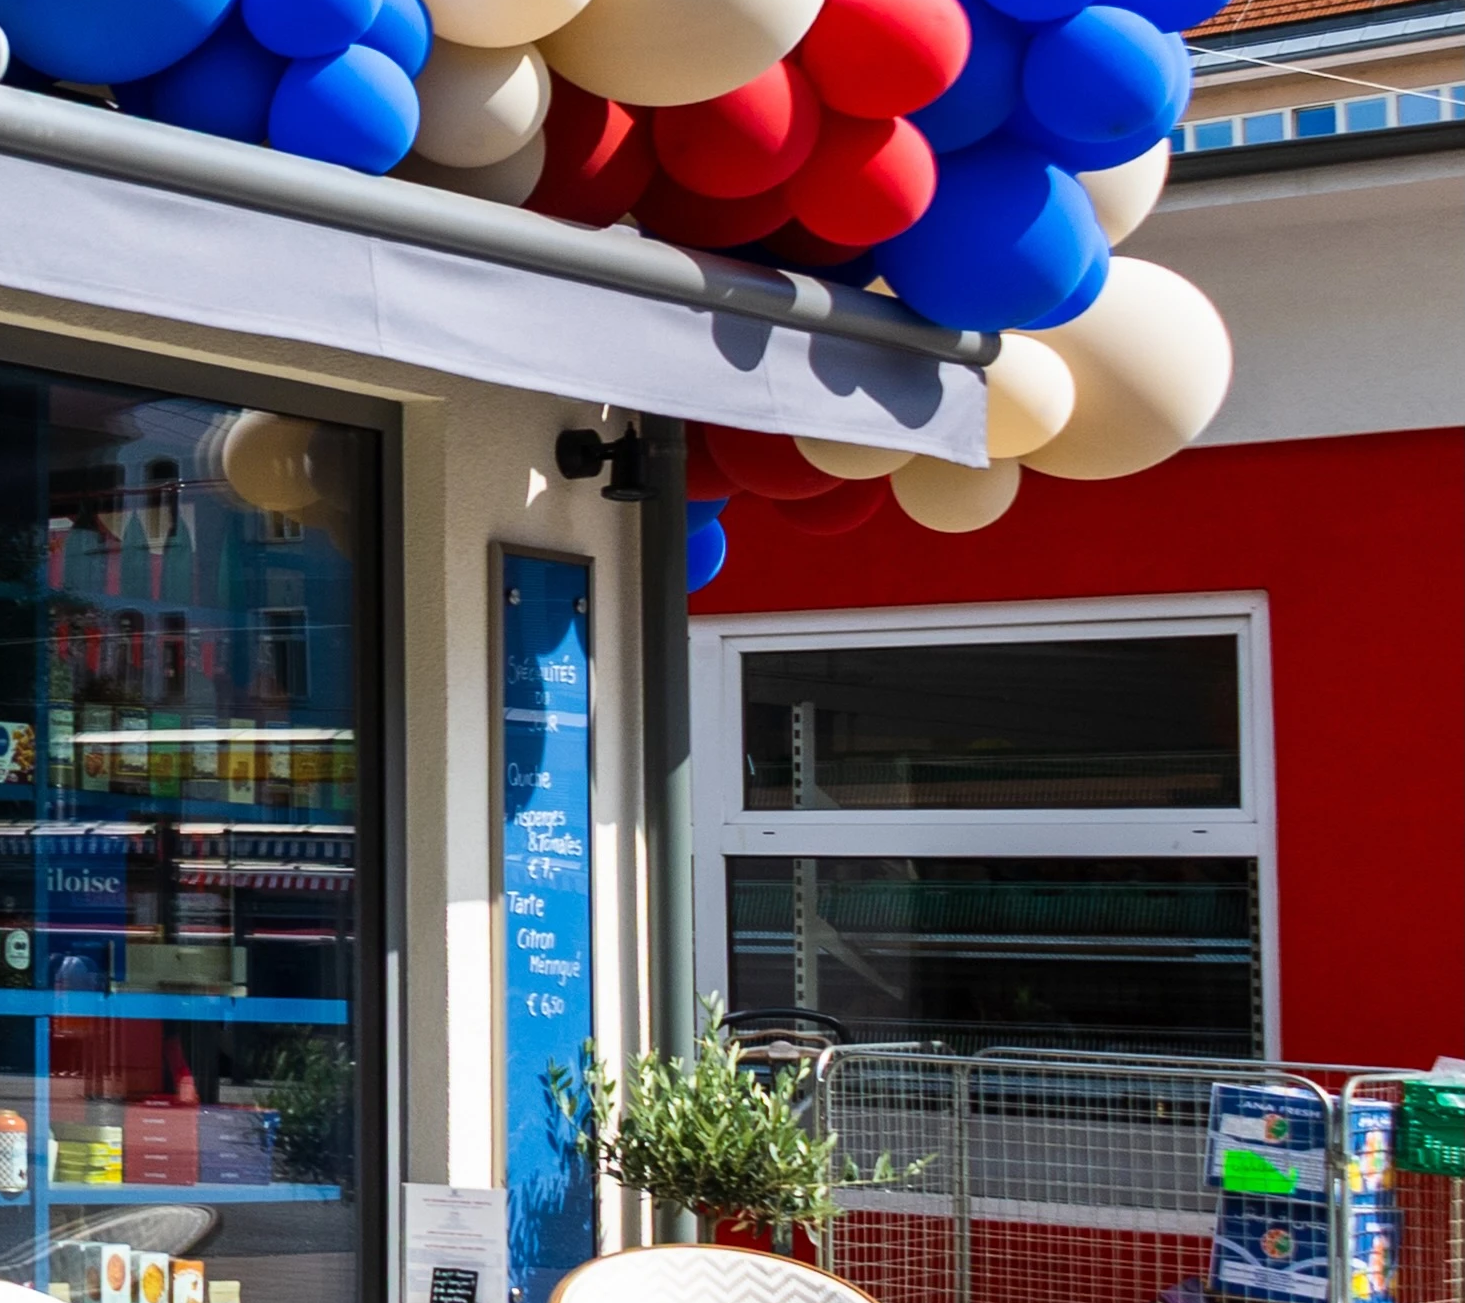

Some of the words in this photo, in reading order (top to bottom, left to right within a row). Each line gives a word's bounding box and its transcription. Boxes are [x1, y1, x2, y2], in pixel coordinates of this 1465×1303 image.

[507, 762, 553, 790] Quiche
[45, 866, 121, 894] iloise
[506, 890, 545, 918] Tarte
[516, 927, 556, 950] Citron
